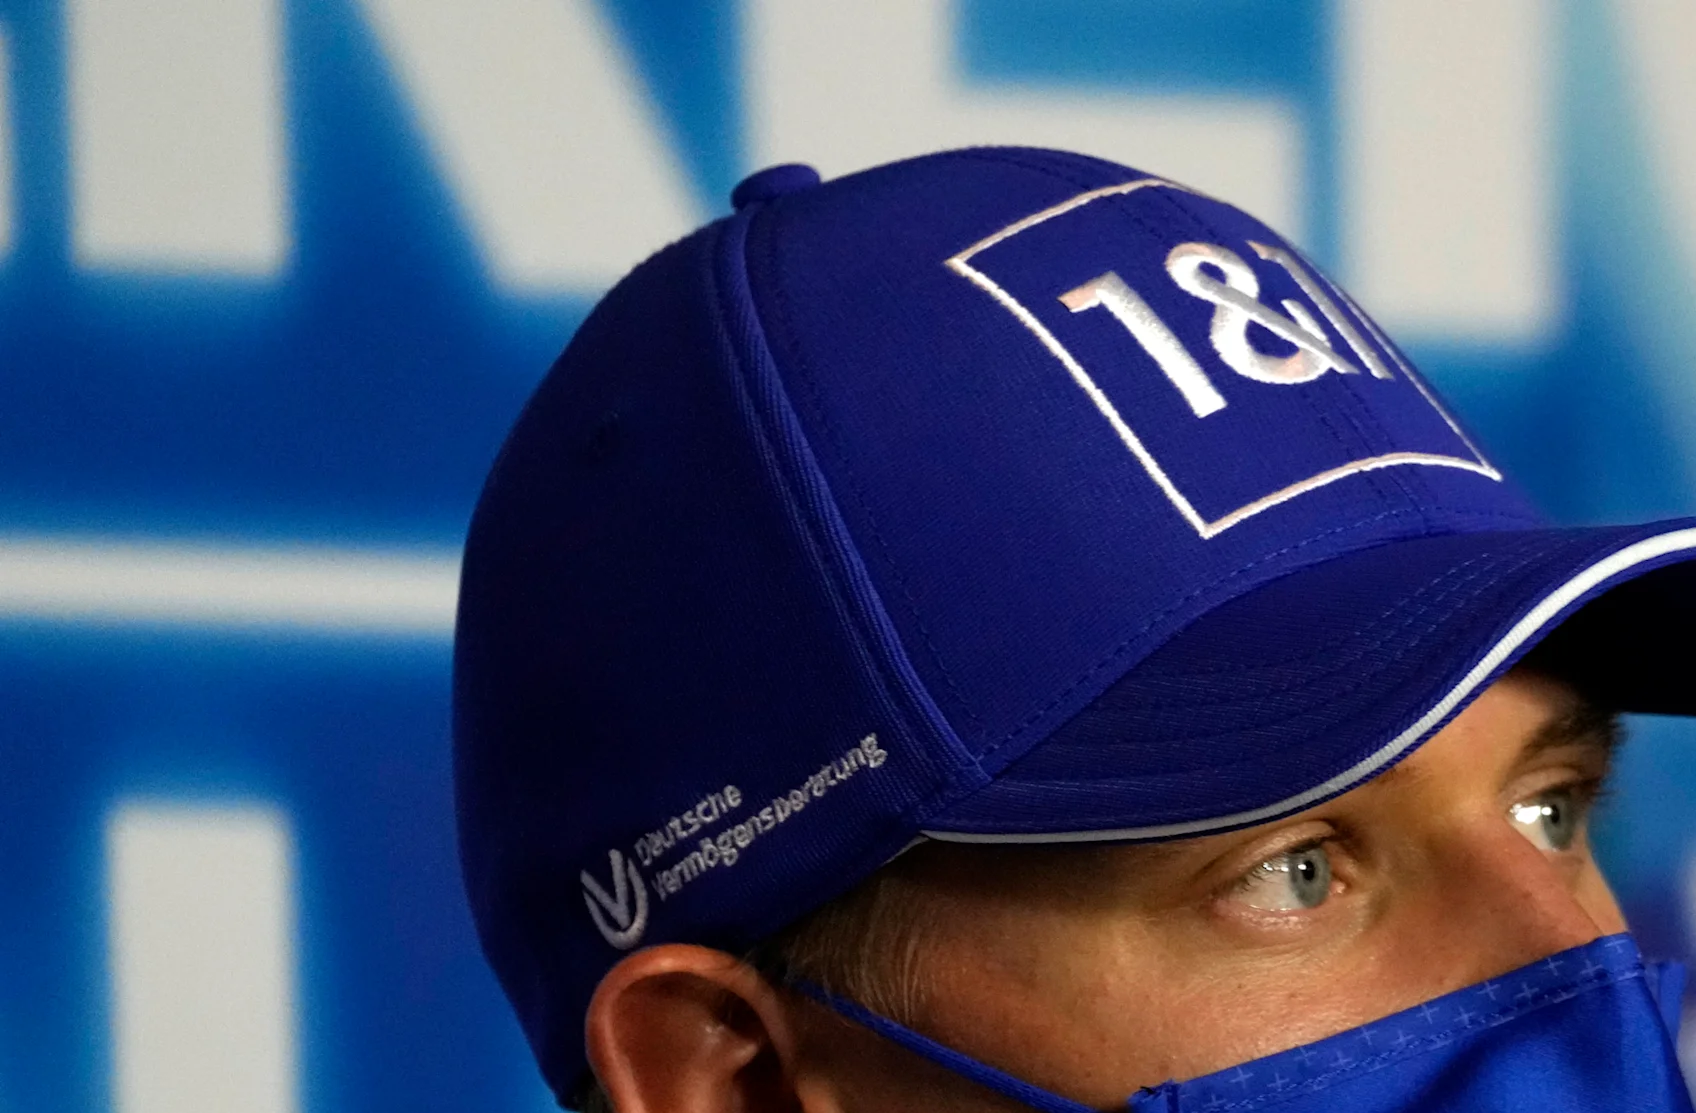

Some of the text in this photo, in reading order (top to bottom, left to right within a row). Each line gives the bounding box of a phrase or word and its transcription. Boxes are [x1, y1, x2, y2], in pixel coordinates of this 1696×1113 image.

[1057, 240, 1393, 418] 1&1
[634, 784, 742, 866] Deutsche
[652, 732, 888, 900] Vermögensberatung
